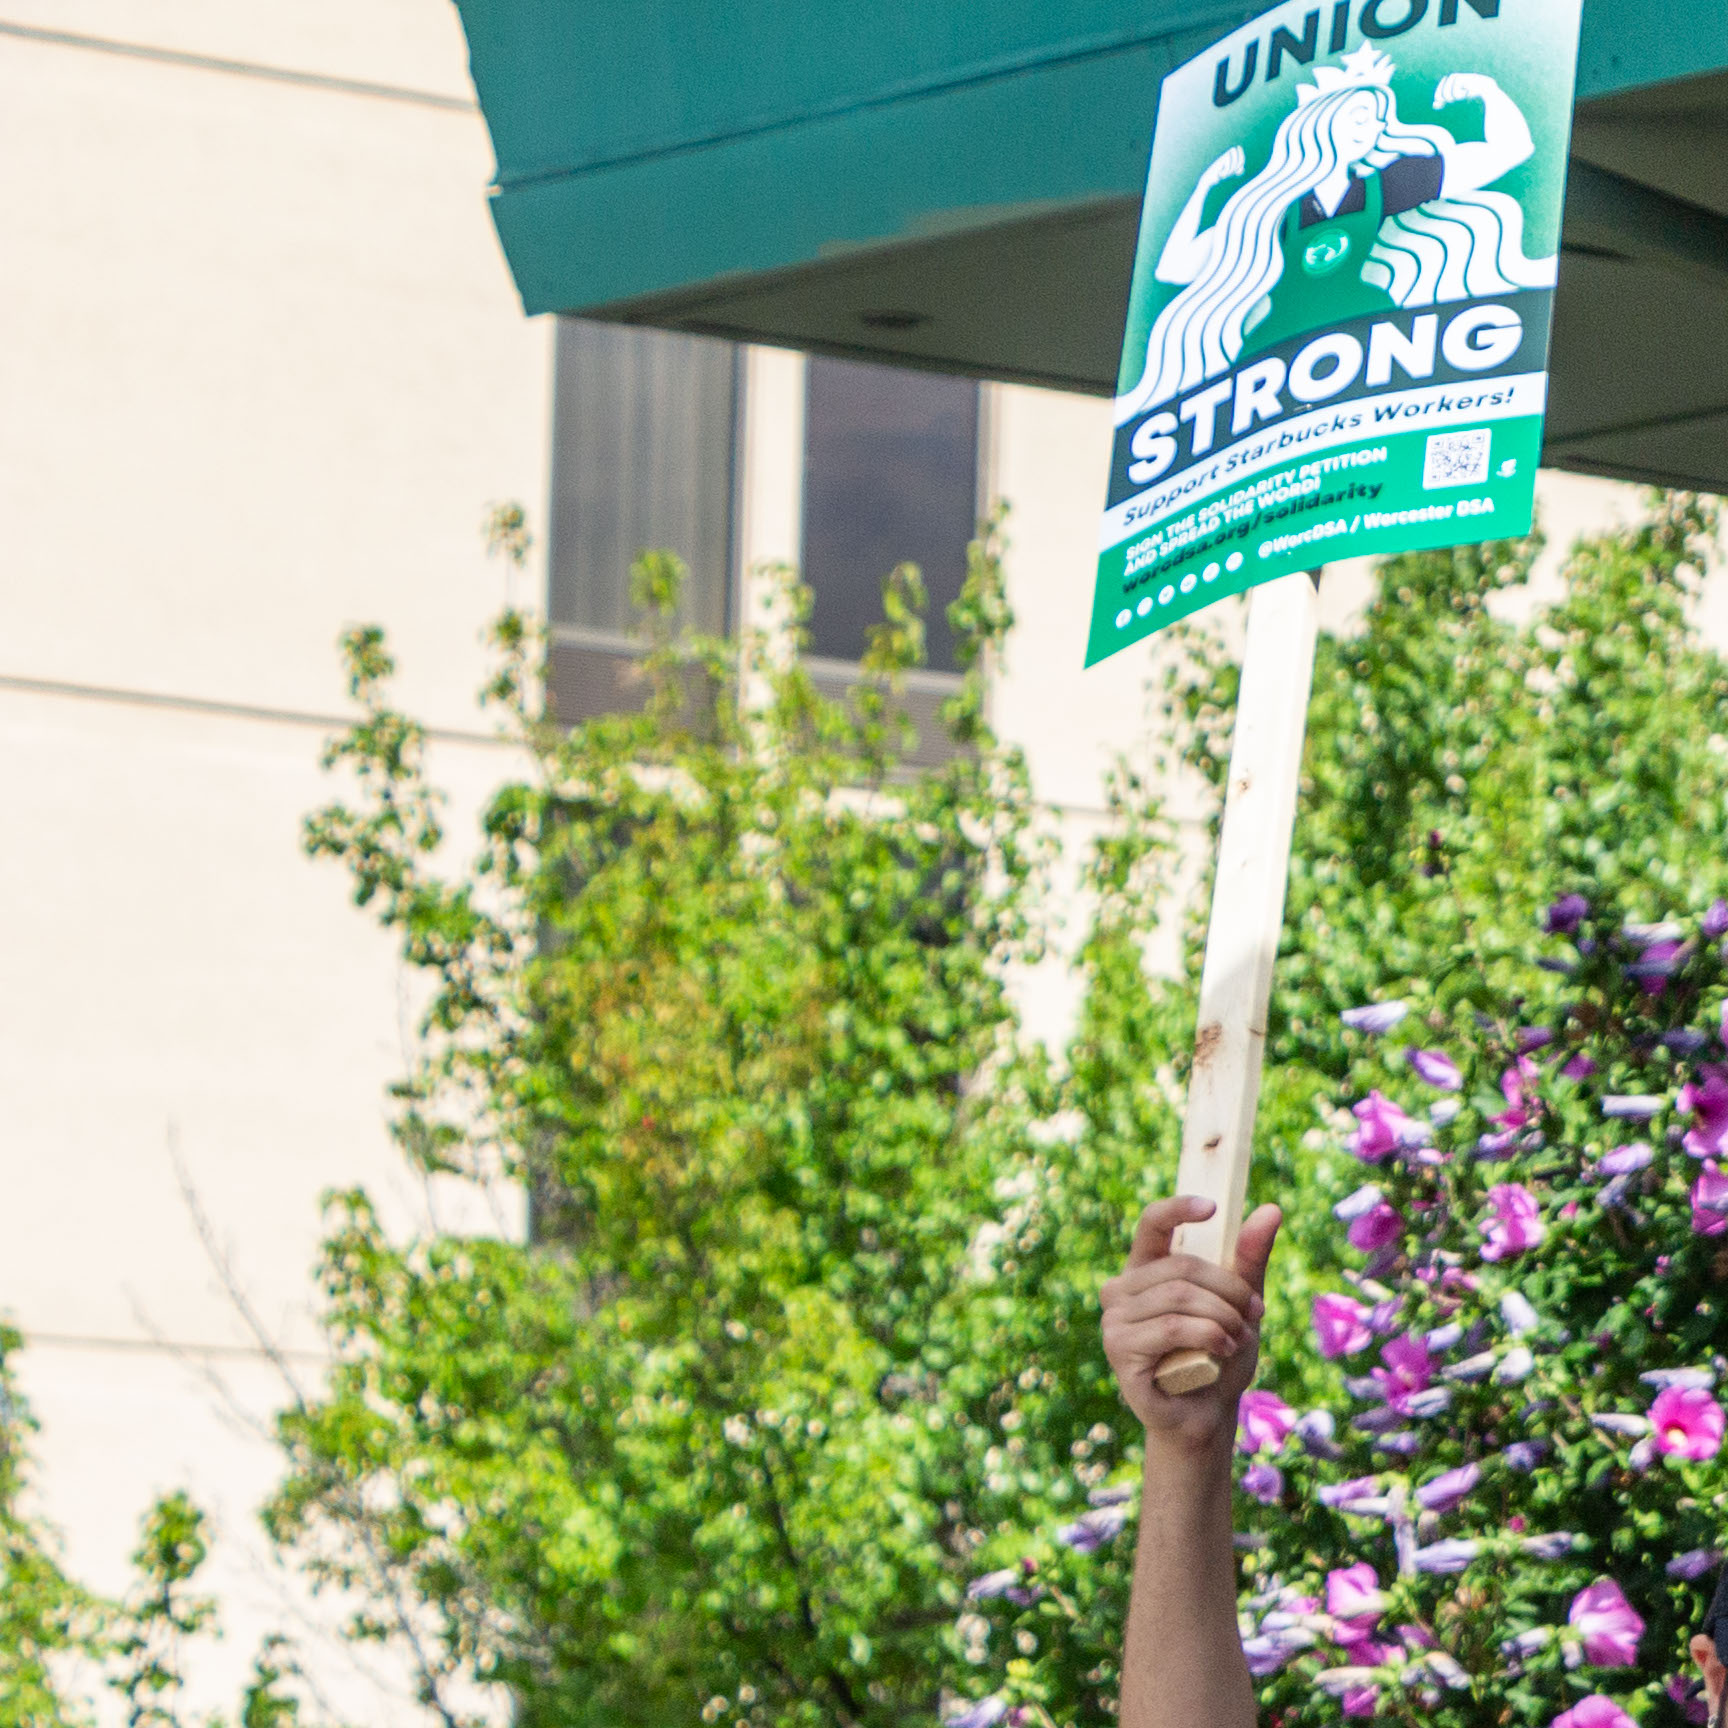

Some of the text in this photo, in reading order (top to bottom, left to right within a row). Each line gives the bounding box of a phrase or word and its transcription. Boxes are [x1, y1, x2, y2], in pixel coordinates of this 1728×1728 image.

[1126, 303, 1523, 485] STRONG
[1123, 387, 1515, 526] Support Starbucks Workers!
[1126, 446, 1388, 561] SIGN THE SOLIDARITY PETITION
[1123, 483, 1383, 593] worcdsa.org/solidarity
[1124, 477, 1321, 577] AND SPREAD THE WORD!
[1258, 519, 1347, 559] @WorcDSA
[1363, 503, 1452, 530] Worcester
[1457, 497, 1494, 516] DSA
